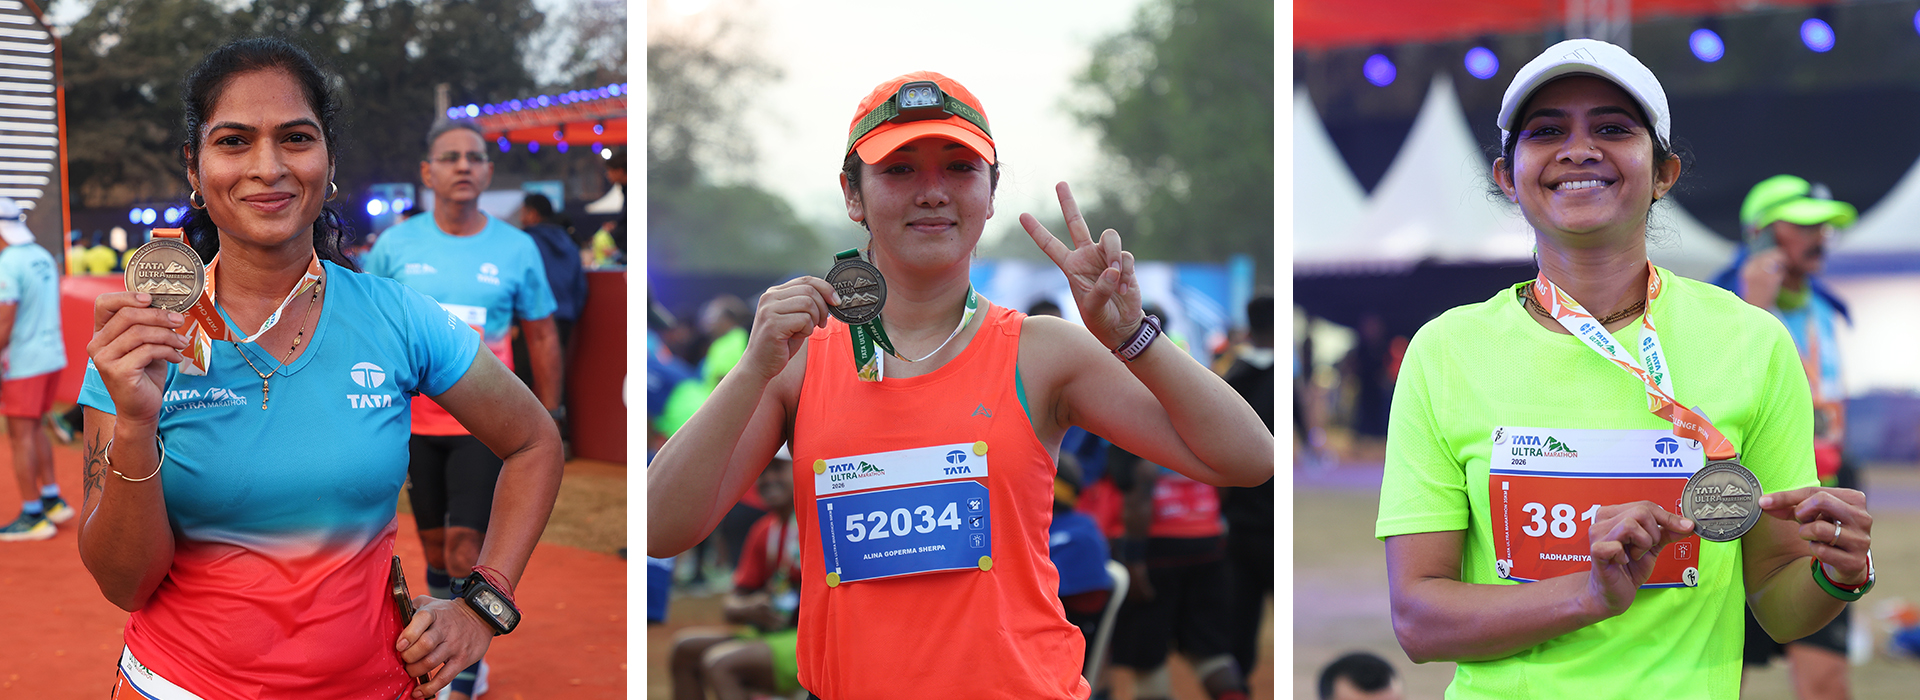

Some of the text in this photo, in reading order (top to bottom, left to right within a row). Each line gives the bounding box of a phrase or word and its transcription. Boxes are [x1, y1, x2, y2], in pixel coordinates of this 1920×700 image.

[139, 262, 165, 270] TATA
[139, 270, 165, 278] ULTRA
[833, 280, 853, 289] TATA
[1595, 331, 1610, 345] TATA
[1651, 351, 1661, 371] TATA
[163, 389, 201, 402] TATA
[164, 400, 207, 413] ULTRA
[207, 399, 247, 408] MARATHON
[346, 394, 392, 409] TATA
[1511, 435, 1541, 446] TATA
[1511, 447, 1543, 457] ULTRA
[1511, 458, 1527, 466] 2026
[1651, 458, 1683, 468] TATA
[828, 463, 855, 473] TATA
[943, 465, 972, 475] TATA
[830, 472, 857, 482] ULTRA
[858, 470, 886, 478] MARATHON
[1694, 486, 1721, 495] TATA
[1694, 495, 1721, 503] ULTRA
[845, 502, 961, 543] 52034
[1521, 502, 1602, 539] 381
[863, 544, 946, 560] ALINA GOPERMA SHERPA
[1539, 553, 1592, 562] RADHAPRIYA
